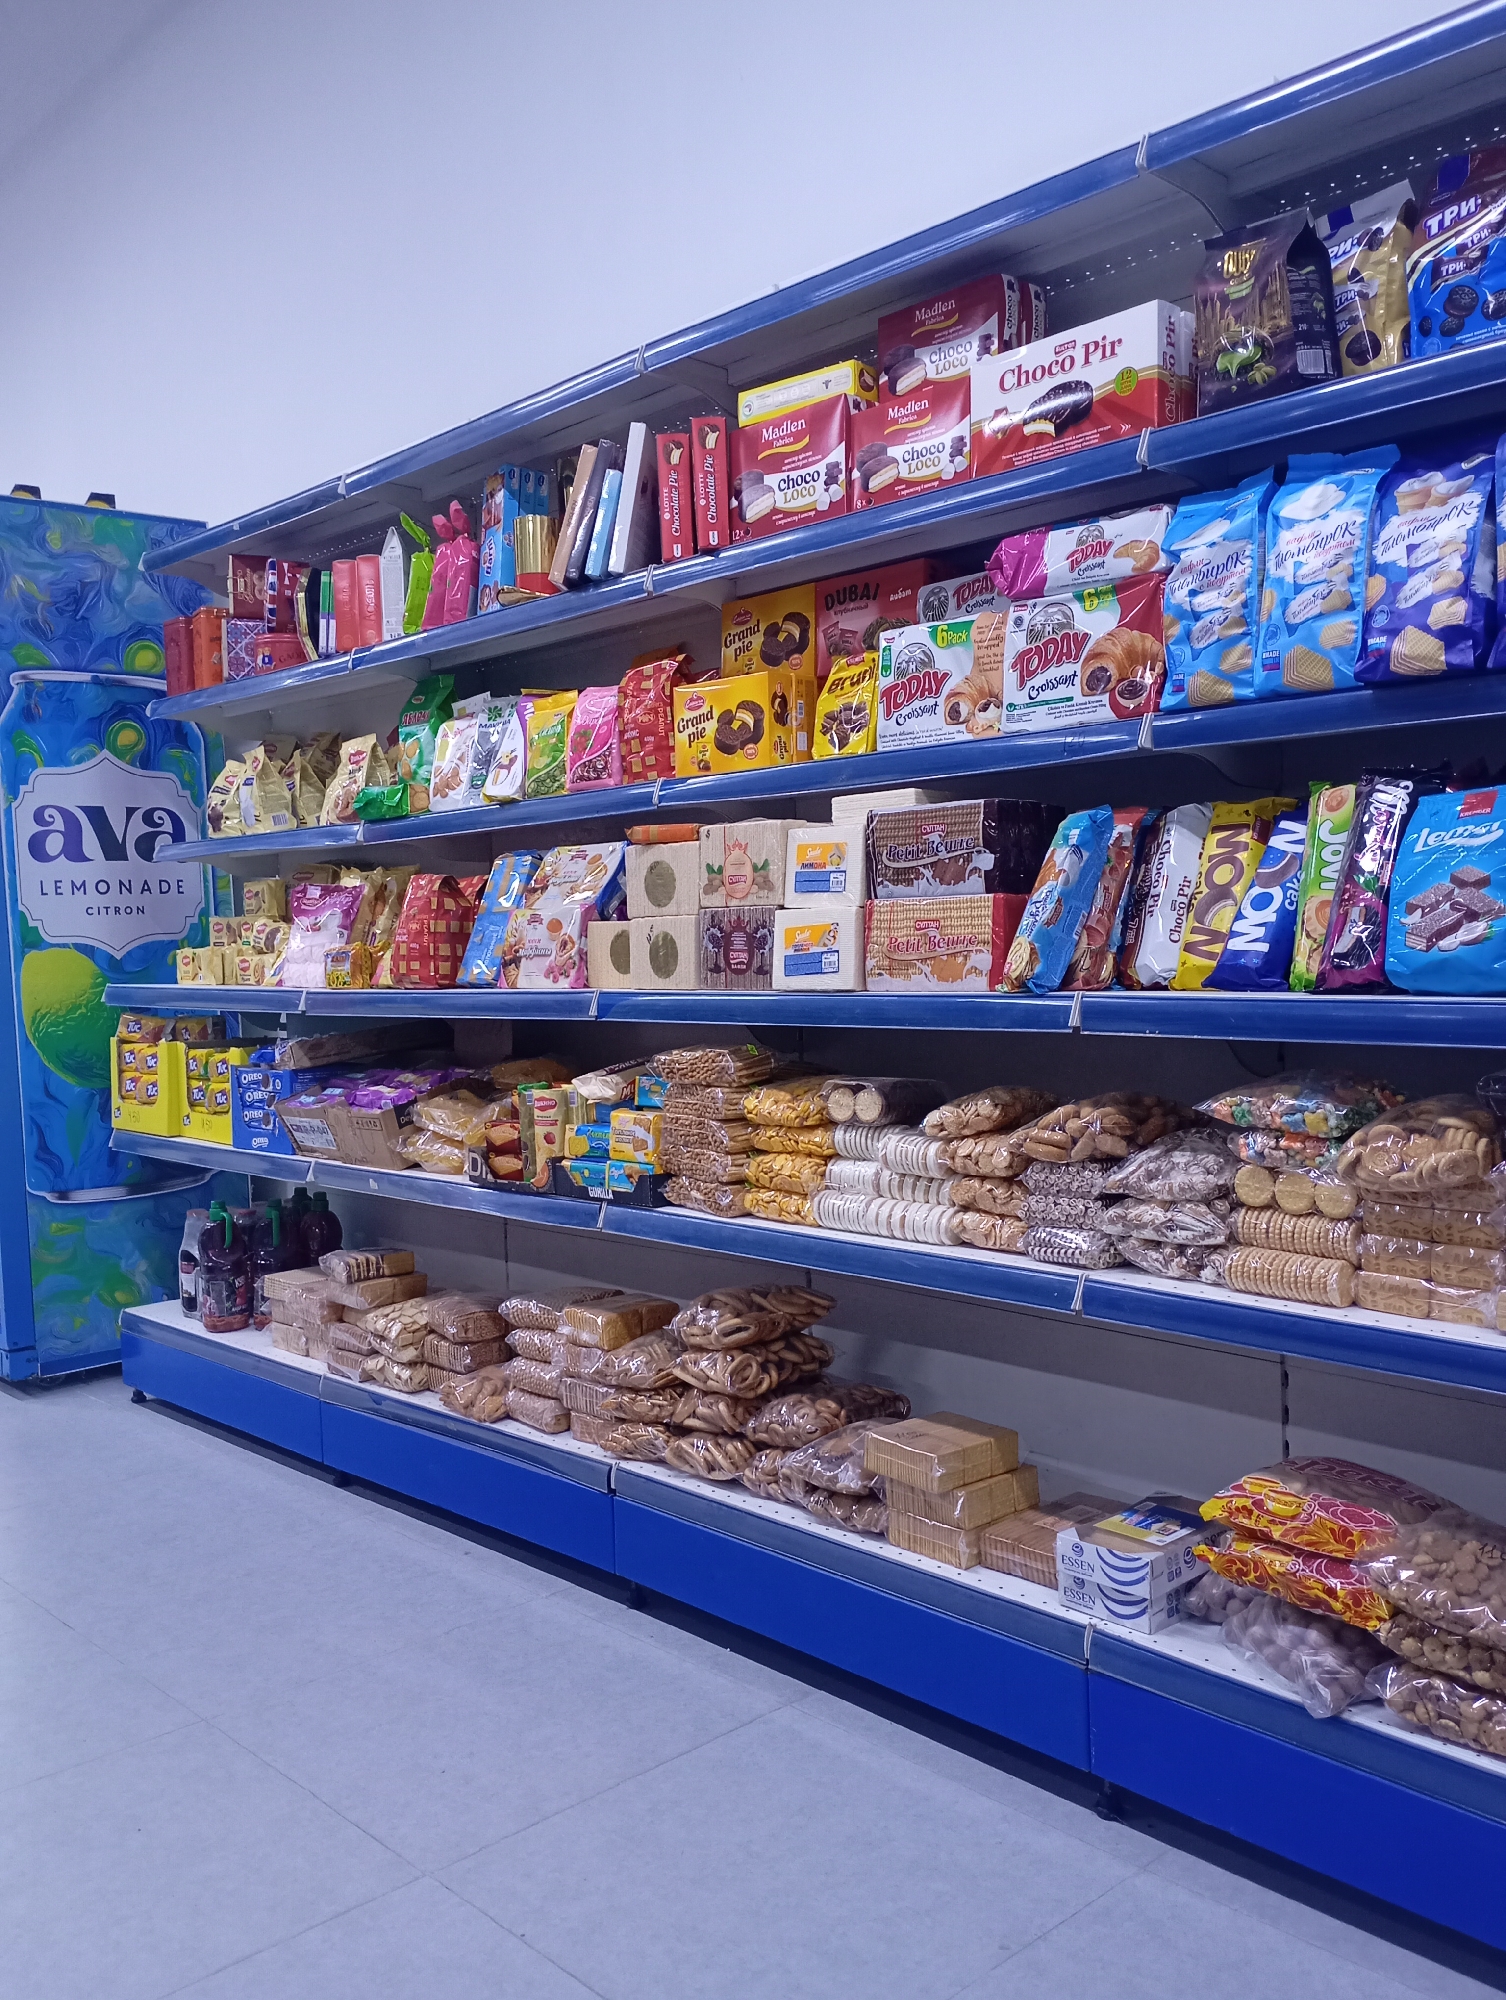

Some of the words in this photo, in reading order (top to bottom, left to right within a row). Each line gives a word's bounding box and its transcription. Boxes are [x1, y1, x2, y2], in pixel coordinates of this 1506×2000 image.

[914, 300, 956, 323] Madlen
[1164, 315, 1176, 348] Pir
[999, 354, 1076, 394] Choco
[1081, 335, 1123, 368] Pir
[1120, 369, 1132, 381] 12
[1164, 354, 1176, 422] Choco
[887, 399, 929, 420] Madlen
[898, 414, 917, 424] Fabrica
[761, 418, 806, 443] Madlen
[773, 436, 794, 448] Fabrica
[704, 454, 713, 472] Pie
[669, 470, 678, 485] Pie
[706, 473, 718, 524] Chocolate
[671, 486, 681, 536] Chocolate
[1066, 539, 1114, 573] TODAY
[1077, 560, 1106, 576] Croissant
[824, 582, 880, 612] DUBAI
[965, 595, 996, 613] Croissant
[1083, 588, 1098, 611] 6
[724, 619, 761, 650] Grand
[937, 624, 948, 648] 6
[948, 631, 968, 644] Pack
[733, 639, 754, 662] pie
[1010, 631, 1092, 691] TODAY
[879, 669, 953, 720] TODAY
[1028, 670, 1078, 700] Croissant
[658, 707, 666, 737] PEANUT
[676, 705, 715, 734] Grand
[895, 701, 940, 726] Croissant
[687, 725, 707, 748] pie
[27, 804, 186, 864] ava
[887, 844, 923, 860] Petit
[927, 836, 975, 857] Beurre
[1152, 840, 1172, 889] Choco
[40, 878, 185, 896] LEMONADE
[1177, 876, 1192, 898] Pir
[1182, 822, 1251, 962] MOON
[1226, 820, 1310, 953] MOON
[86, 905, 145, 916] CITRON
[1169, 900, 1187, 944] Choco
[888, 937, 922, 953] Petit
[927, 934, 978, 951] Beurre
[241, 1072, 263, 1084] OREO
[245, 1090, 269, 1103] OREO
[243, 1110, 263, 1122] OREO
[251, 1136, 269, 1149] OREO
[1061, 1554, 1095, 1573] ESSEN
[1063, 1586, 1096, 1605] ESSEN
